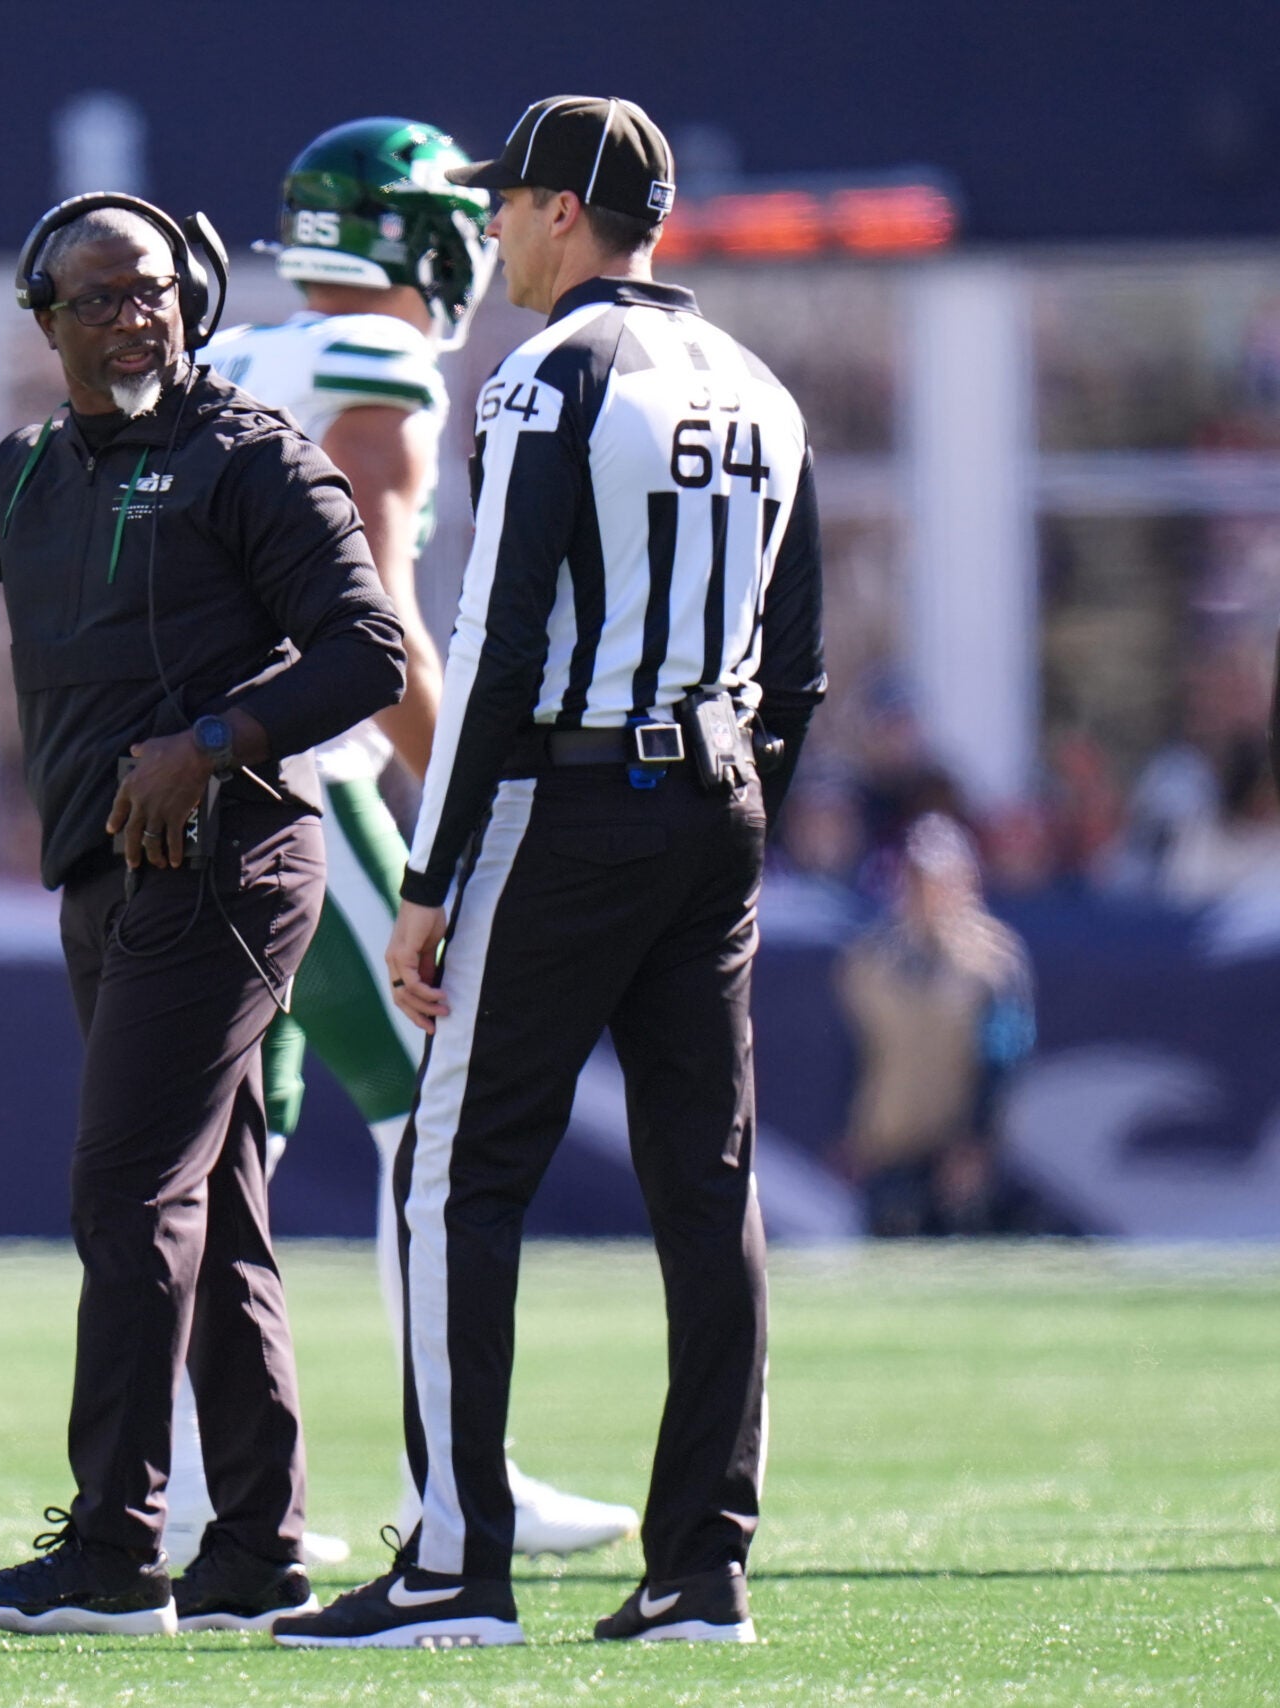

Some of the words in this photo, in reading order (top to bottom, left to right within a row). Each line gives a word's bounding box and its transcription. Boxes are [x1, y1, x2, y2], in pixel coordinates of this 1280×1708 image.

[297, 209, 340, 247] 85
[481, 382, 540, 423] 64
[671, 419, 770, 493] 64
